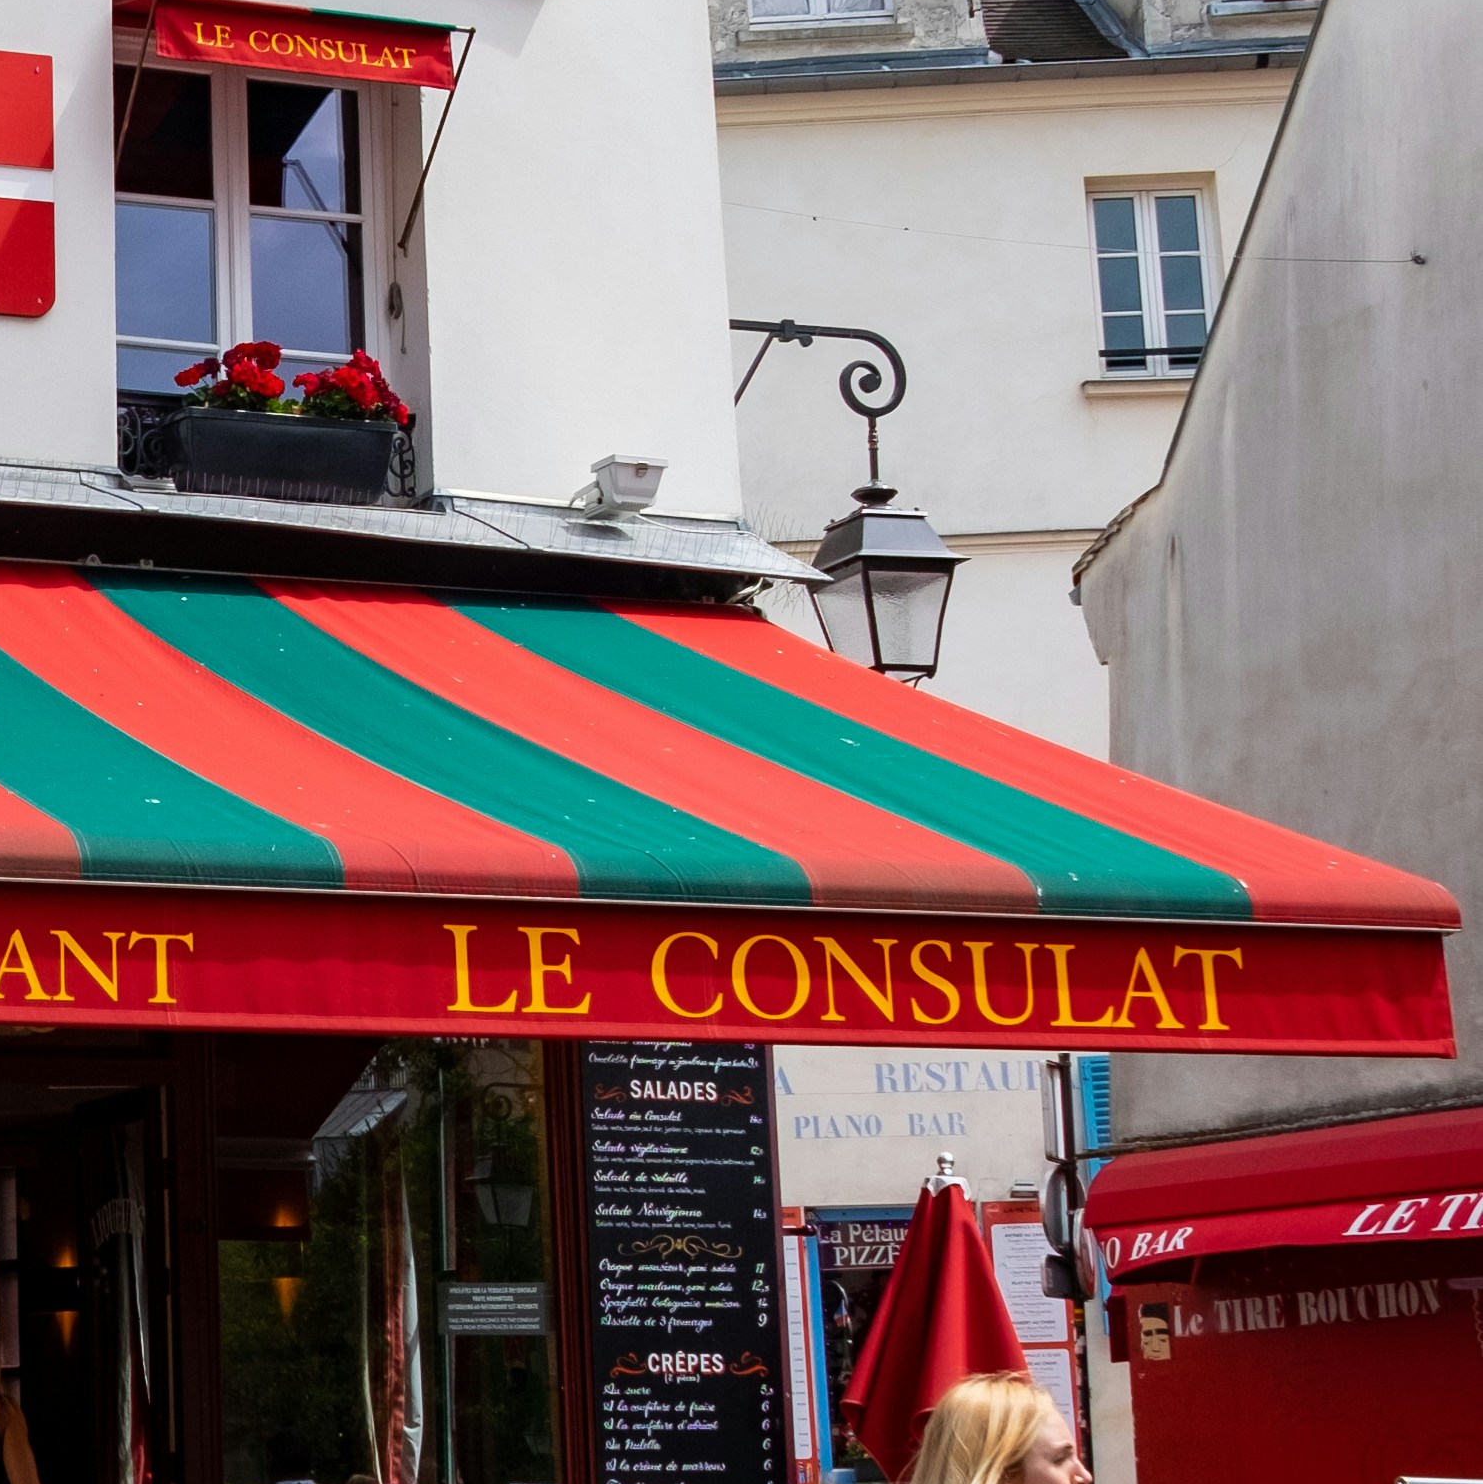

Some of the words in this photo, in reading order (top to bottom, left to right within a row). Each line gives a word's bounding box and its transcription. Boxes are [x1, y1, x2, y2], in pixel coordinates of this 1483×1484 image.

[194, 21, 235, 50] LE
[248, 29, 417, 70] CONSULAT
[443, 924, 592, 1015] LE
[651, 931, 1244, 1032] CONSULAT
[629, 1079, 719, 1101] SALADES
[590, 1107, 626, 1122] Salade
[794, 1114, 883, 1140] PIANO
[908, 1111, 967, 1138] BAR
[591, 1139, 627, 1154] Salade
[593, 1169, 631, 1184] Salade
[634, 1170, 648, 1183] de
[595, 1202, 633, 1217] Salade
[817, 1223, 843, 1244] La
[1128, 1226, 1194, 1262] BAR
[1342, 1197, 1429, 1238] LE
[598, 1257, 634, 1279] Croque
[599, 1277, 635, 1297] Croque
[600, 1294, 648, 1314] Spaghetti
[1173, 1305, 1204, 1338] Le
[1213, 1293, 1286, 1334] TIRE
[1297, 1278, 1441, 1326] BOUCHON
[600, 1313, 642, 1328] Assiette
[643, 1316, 657, 1327] de
[658, 1315, 667, 1328] 3
[667, 1316, 714, 1334] fromages
[758, 1313, 768, 1328] 9
[646, 1350, 725, 1375] CRÊPES
[624, 1386, 652, 1396] sucre
[674, 1400, 687, 1412] de
[761, 1400, 770, 1413] 6
[761, 1418, 771, 1431] 6
[762, 1437, 771, 1450] 6
[665, 1460, 679, 1472] de
[763, 1458, 773, 1471] 6
